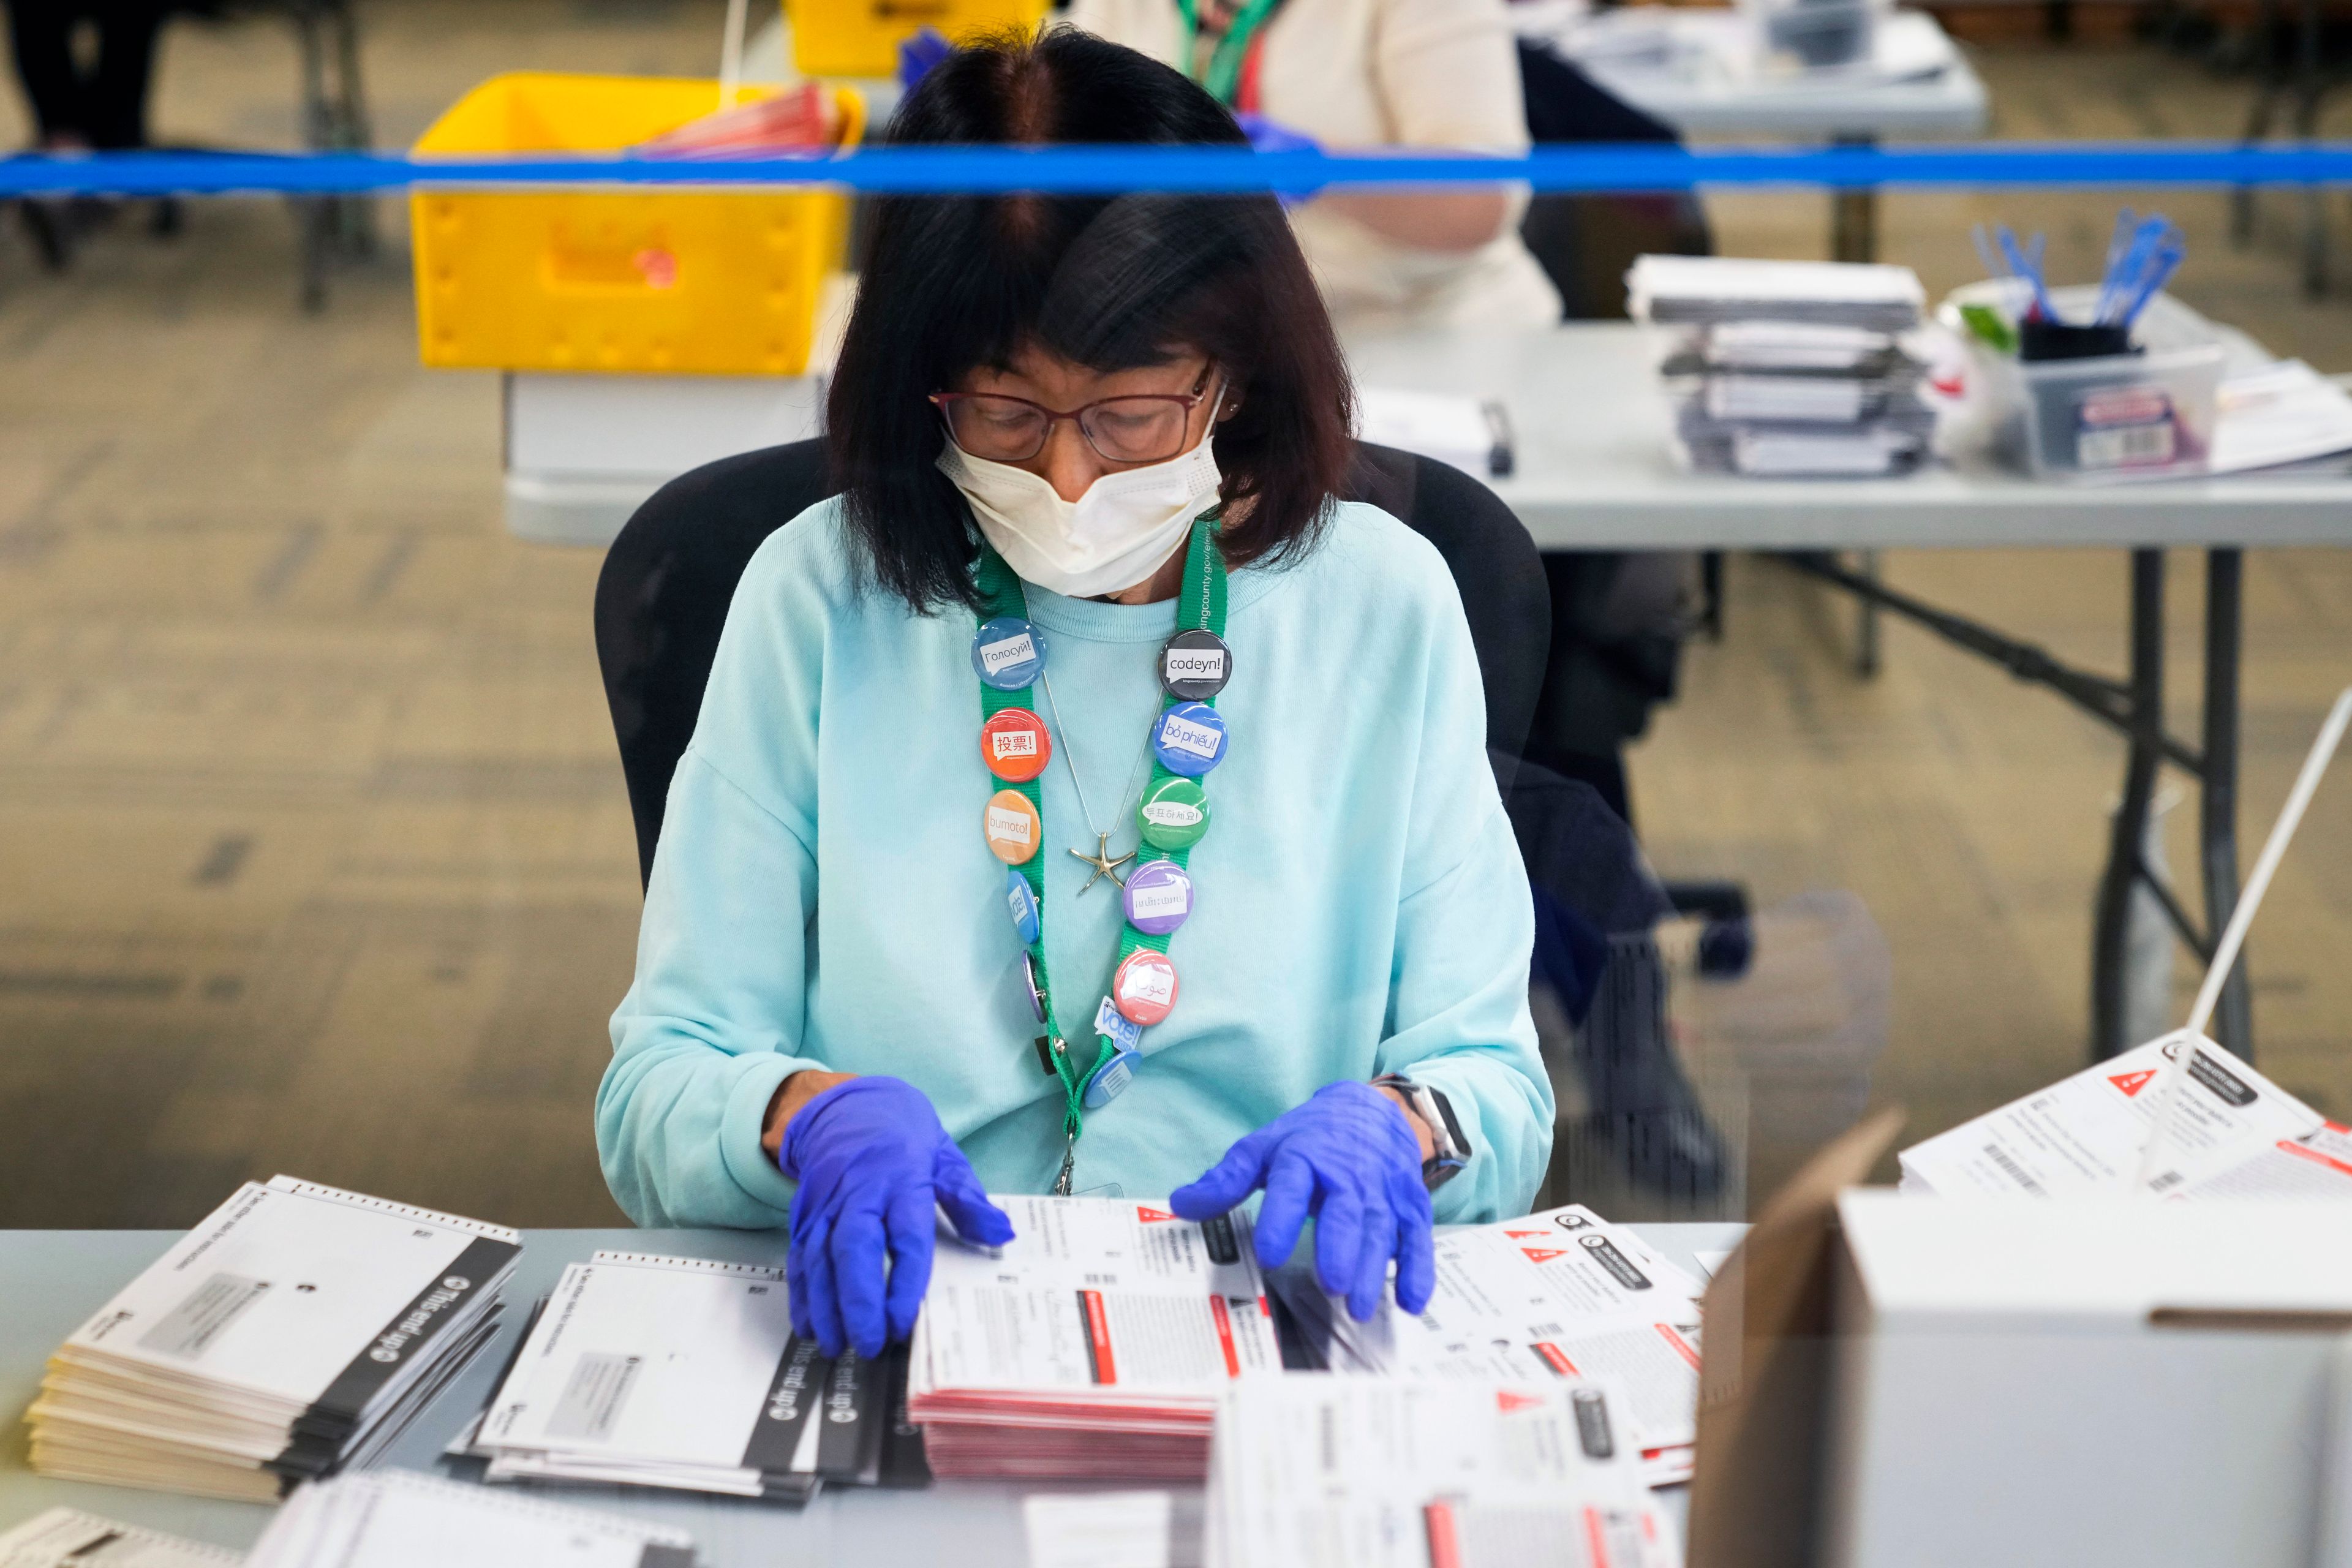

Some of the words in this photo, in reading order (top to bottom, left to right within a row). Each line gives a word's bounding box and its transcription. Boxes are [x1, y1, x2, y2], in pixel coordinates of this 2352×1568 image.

[985, 641, 1031, 663] Голосуй!
[1170, 657, 1220, 673] codeyn!
[1166, 723, 1181, 738] bỏ
[1181, 731, 1218, 750] phiếu!
[990, 815, 1028, 834] bumoto!
[1147, 807, 1199, 821] 투표하세요!
[1011, 889, 1025, 917] vote!
[420, 1288, 461, 1312] This
[399, 1308, 432, 1336] end
[379, 1330, 412, 1349] up
[782, 1366, 807, 1389] end
[835, 1367, 859, 1390] end
[770, 1389, 798, 1407] up
[826, 1392, 853, 1409] up
